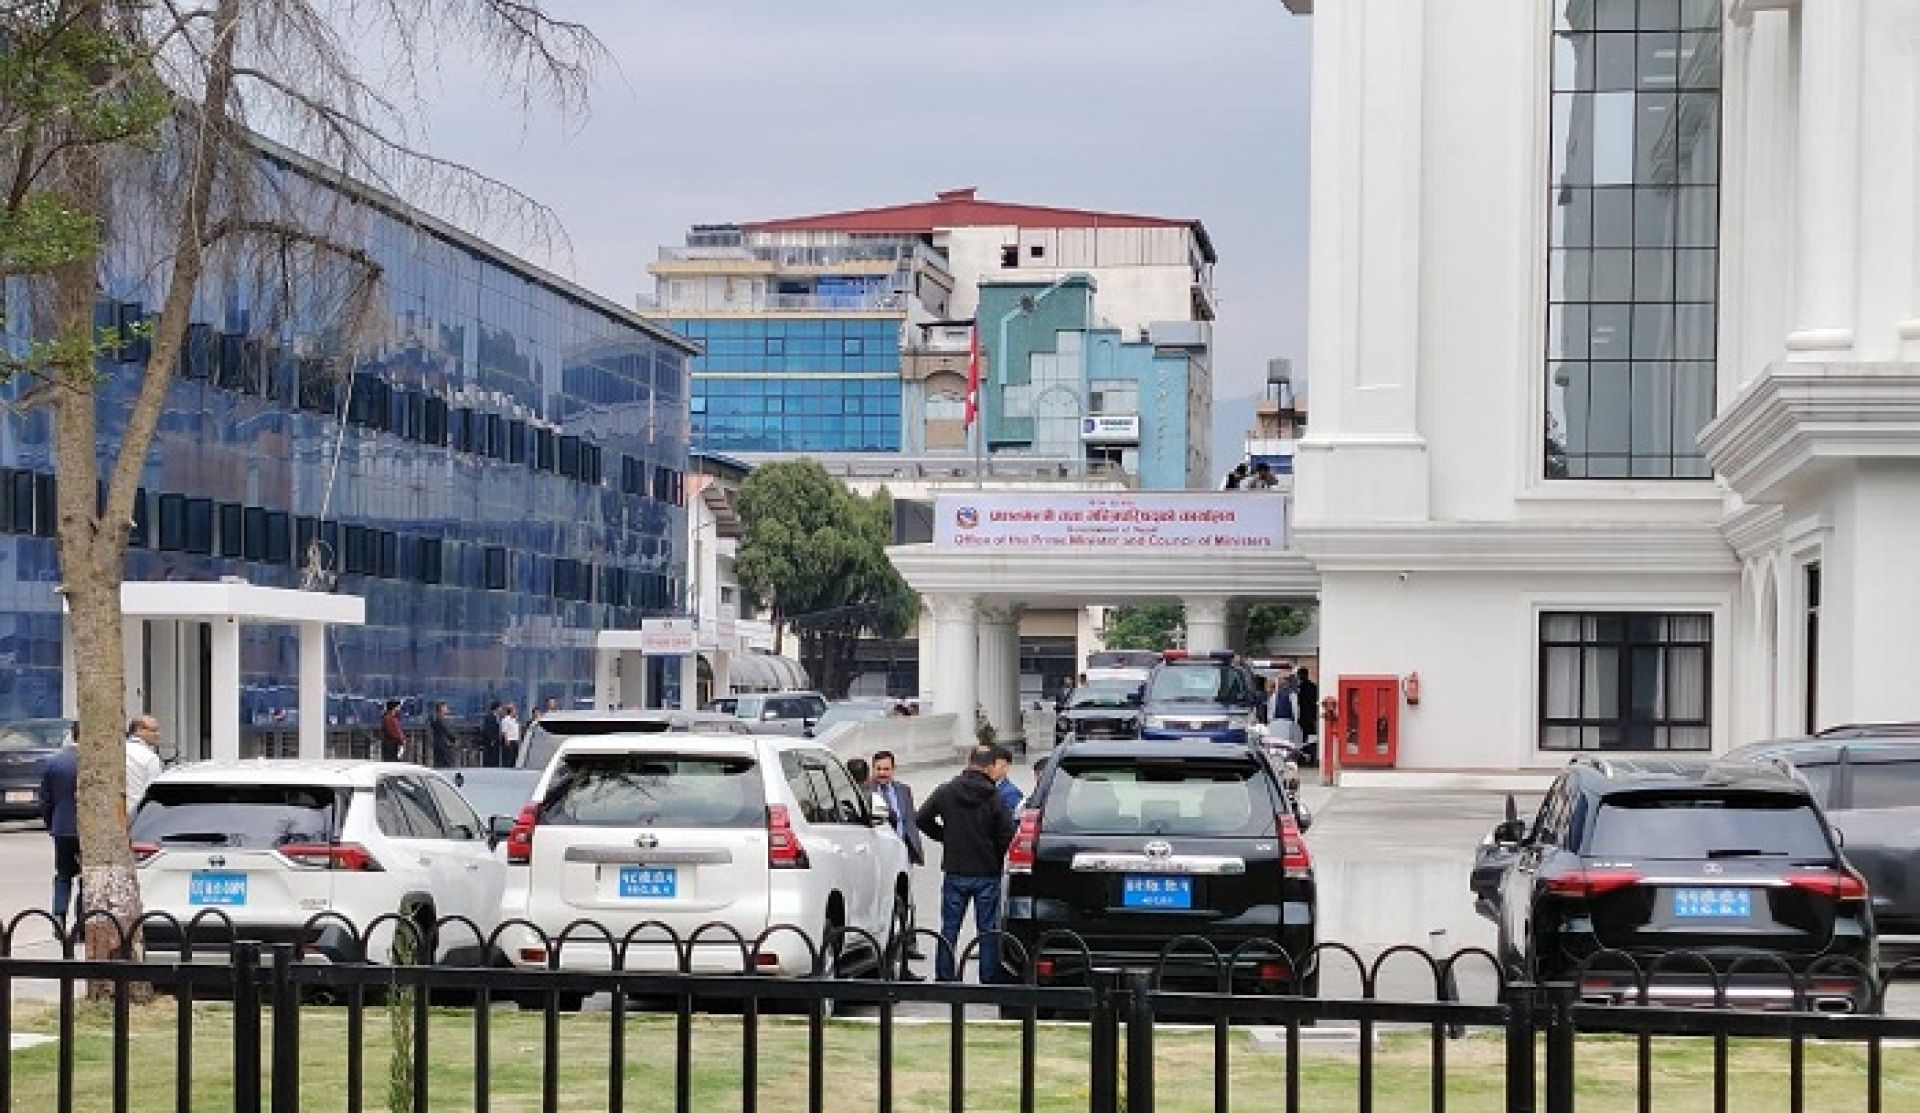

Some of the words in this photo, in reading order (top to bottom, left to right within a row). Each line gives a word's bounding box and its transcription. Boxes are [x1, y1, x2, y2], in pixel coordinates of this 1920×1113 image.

[955, 534, 990, 546] Office
[993, 534, 1006, 547] of
[1009, 534, 1029, 546] the
[1031, 534, 1066, 546] Prime
[1069, 534, 1118, 546] Minister
[1124, 535, 1145, 547] and
[1149, 535, 1194, 547] Council
[1199, 535, 1212, 547] of
[1215, 535, 1271, 547] Ministers
